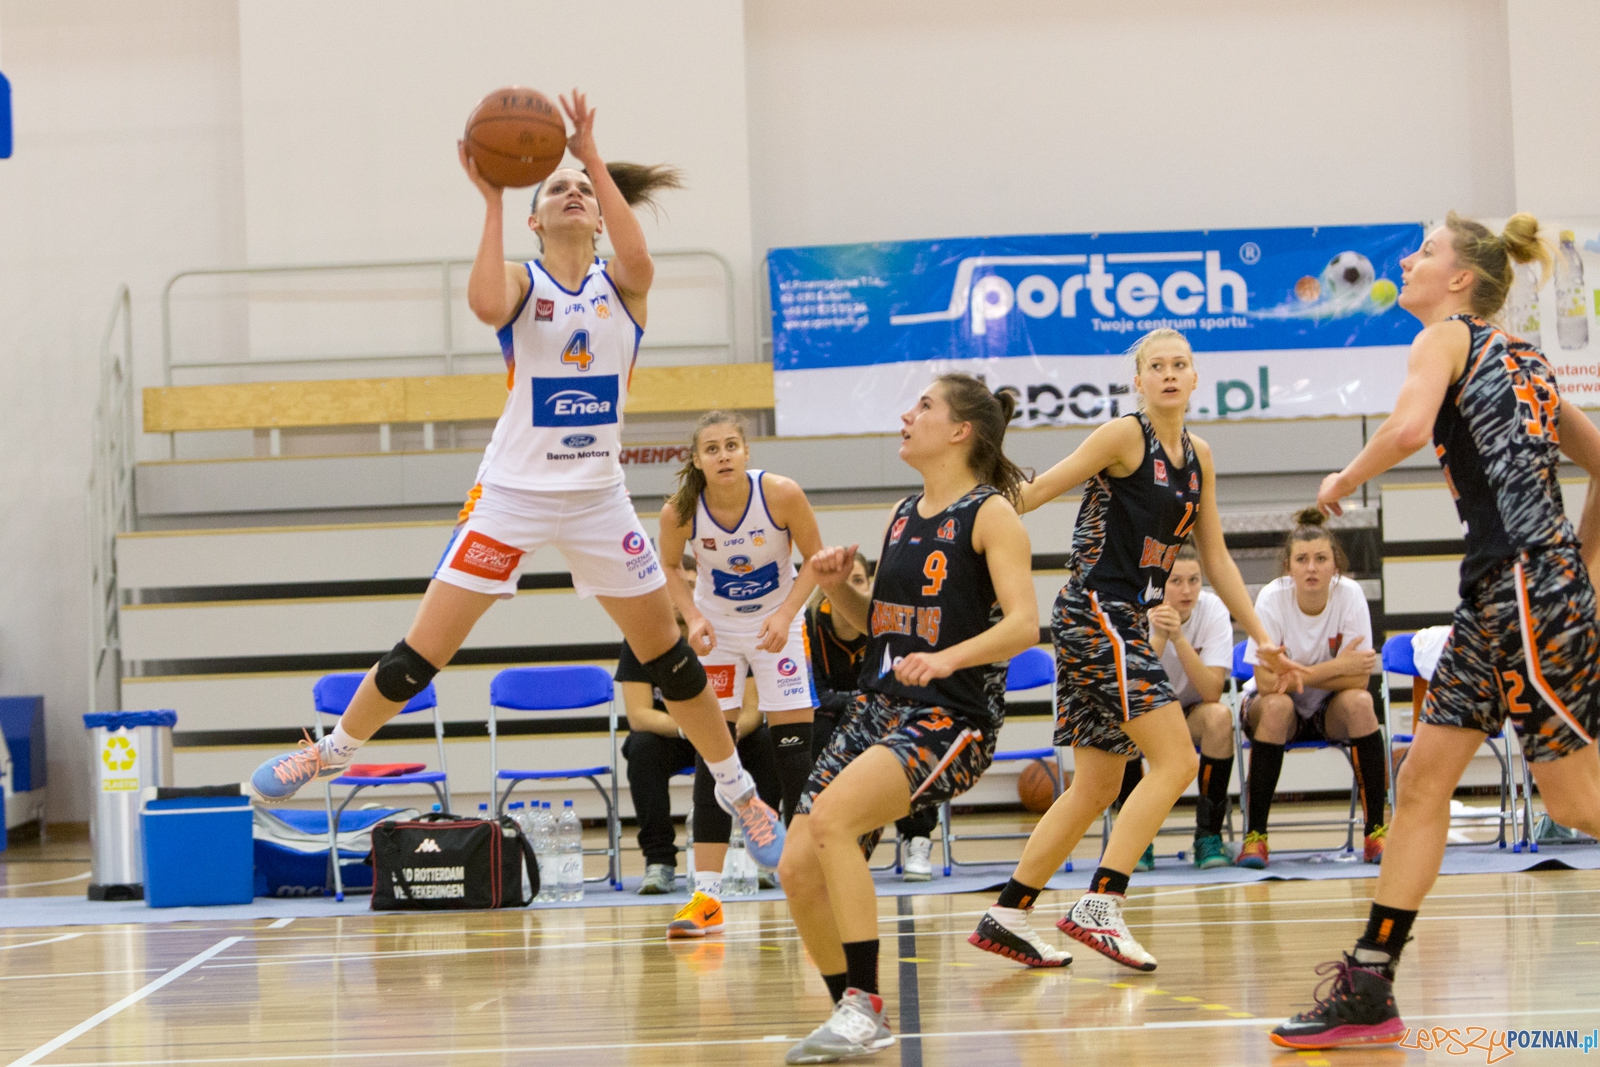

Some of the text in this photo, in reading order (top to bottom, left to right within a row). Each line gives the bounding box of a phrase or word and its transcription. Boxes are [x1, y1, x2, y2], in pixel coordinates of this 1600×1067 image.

[1092, 316, 1248, 333] Twoje centrum sportu
[561, 329, 594, 371] 4
[554, 399, 611, 415] Enea
[547, 450, 610, 460] Bemo Motors
[922, 550, 948, 596] 9
[413, 866, 465, 882] ROTTERDAM
[393, 883, 465, 899] VEZEKERINGEN
